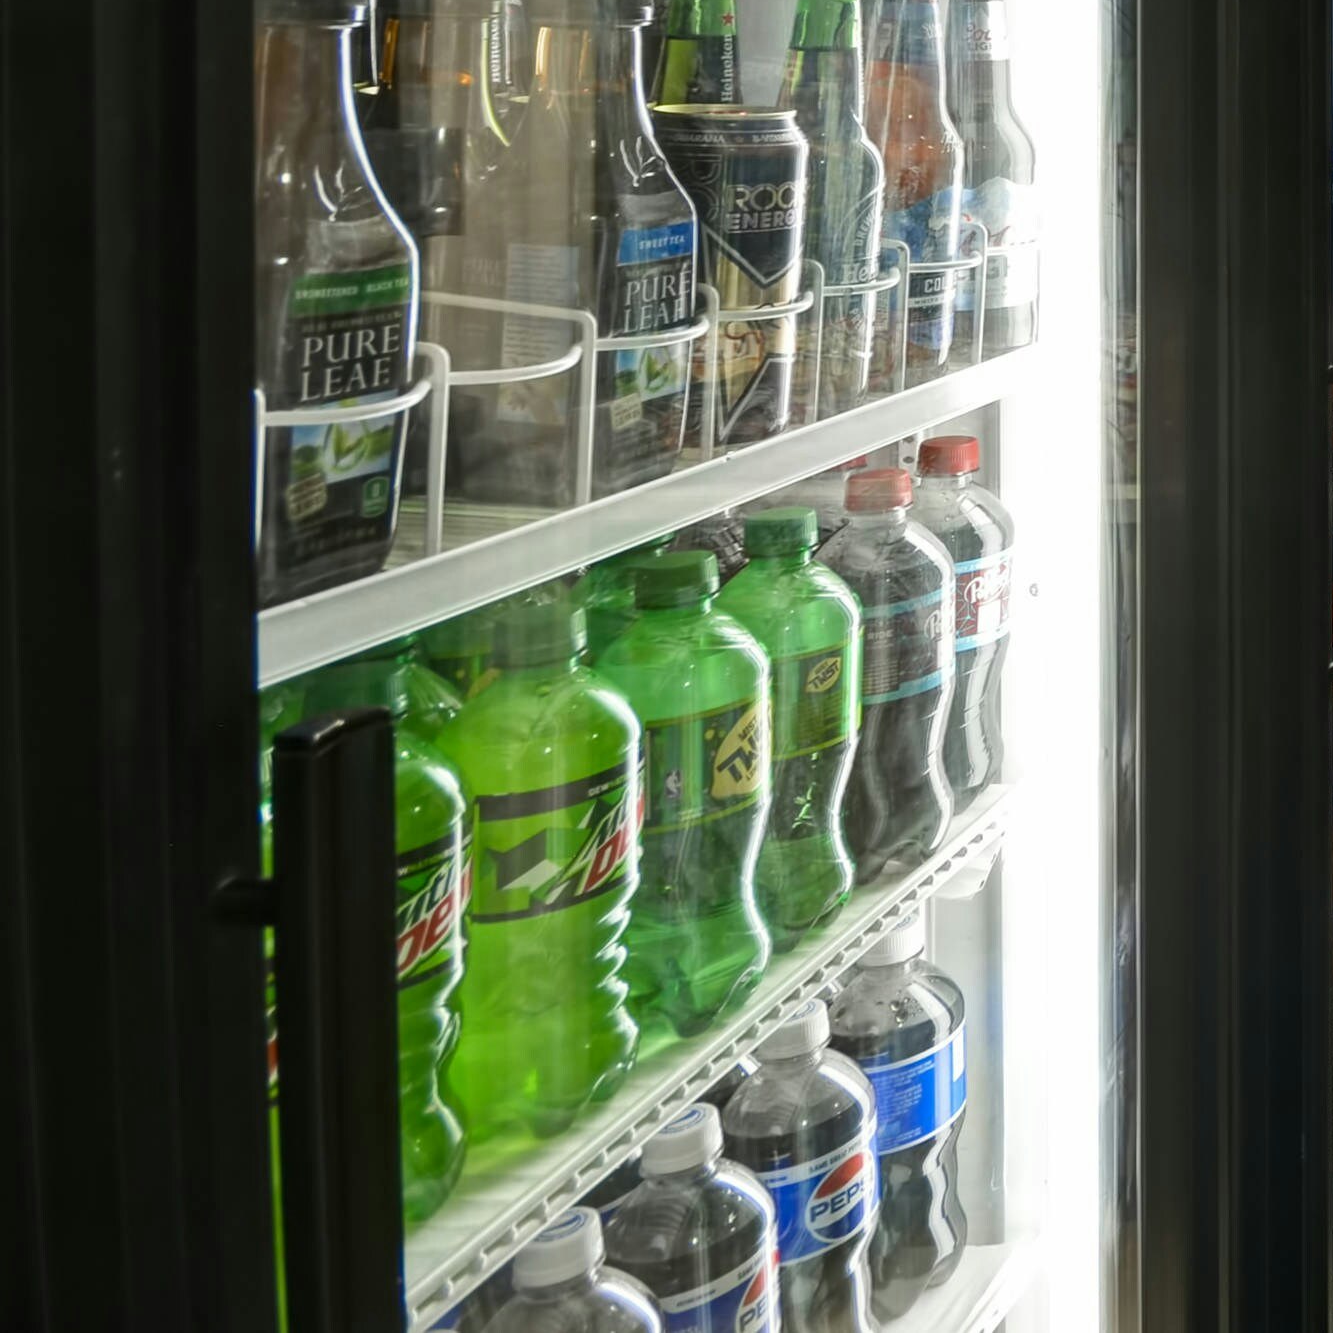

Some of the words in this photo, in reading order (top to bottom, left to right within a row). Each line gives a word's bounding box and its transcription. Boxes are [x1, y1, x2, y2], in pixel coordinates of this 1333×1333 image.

[720, 33, 736, 103] Heineken
[625, 270, 692, 306] PURE
[304, 322, 400, 368] PURE
[301, 359, 391, 403] LEAF
